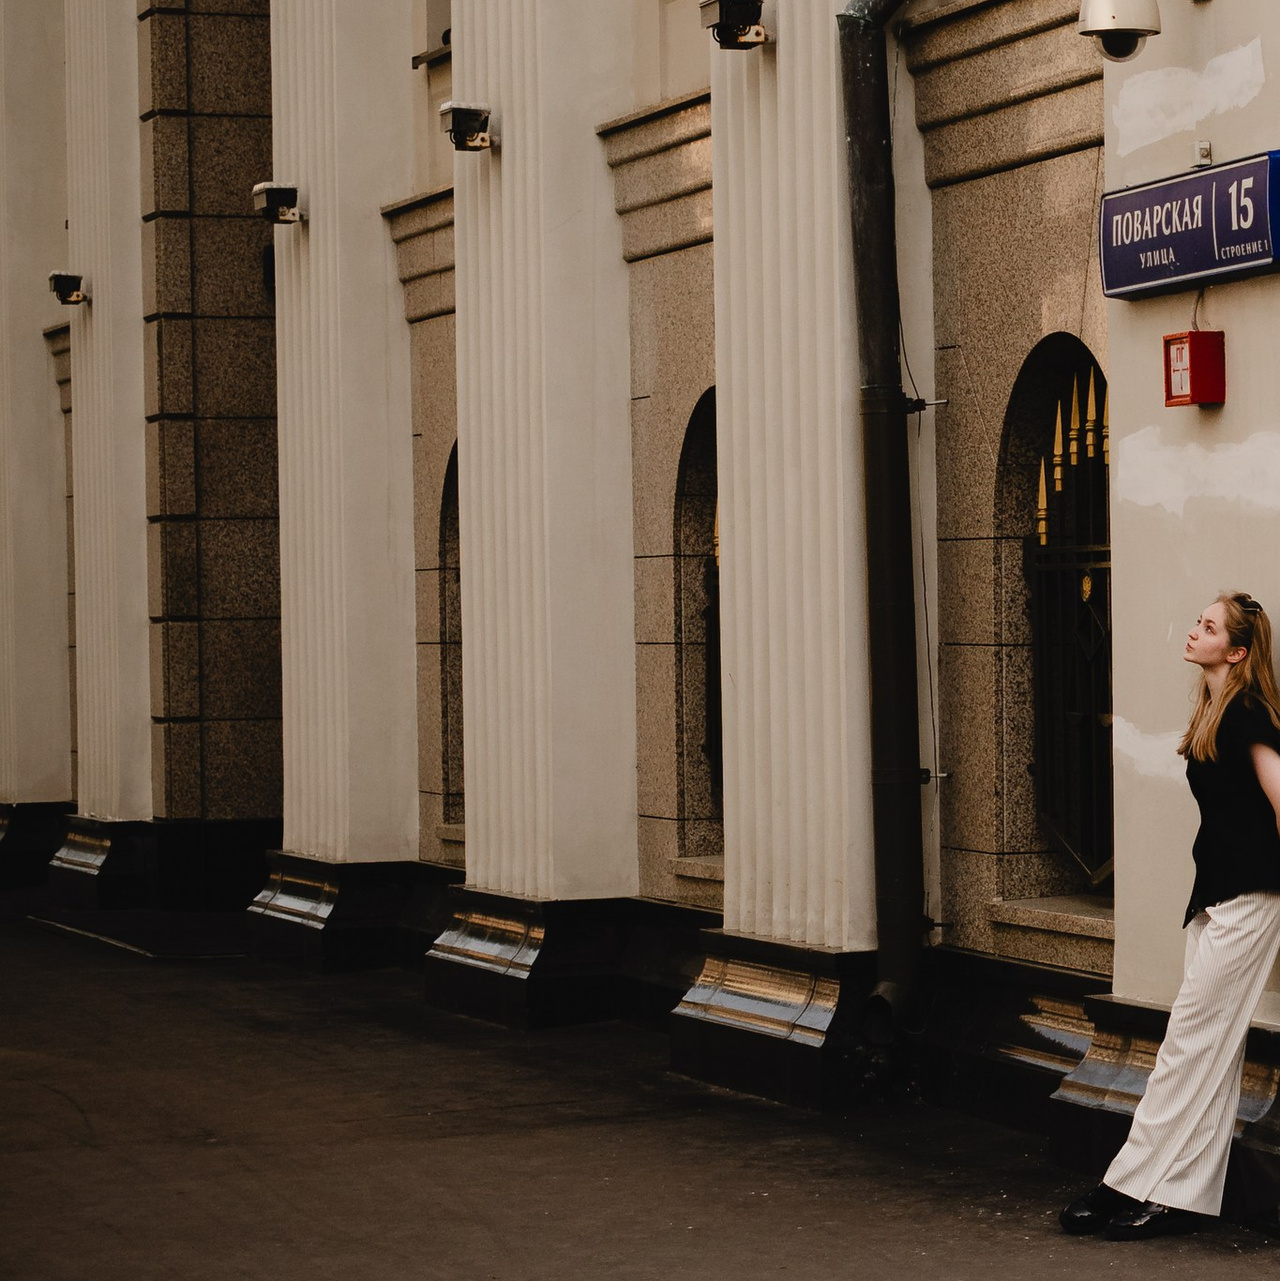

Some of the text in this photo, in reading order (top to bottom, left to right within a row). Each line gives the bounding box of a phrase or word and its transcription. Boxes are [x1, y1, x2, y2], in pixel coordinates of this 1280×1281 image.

[1112, 194, 1203, 246] ПОВАРСКАЯ
[1228, 176, 1254, 230] 15
[1139, 246, 1175, 269] УЛИЦА
[1221, 239, 1269, 259] СТРОЕНИЕ 1
